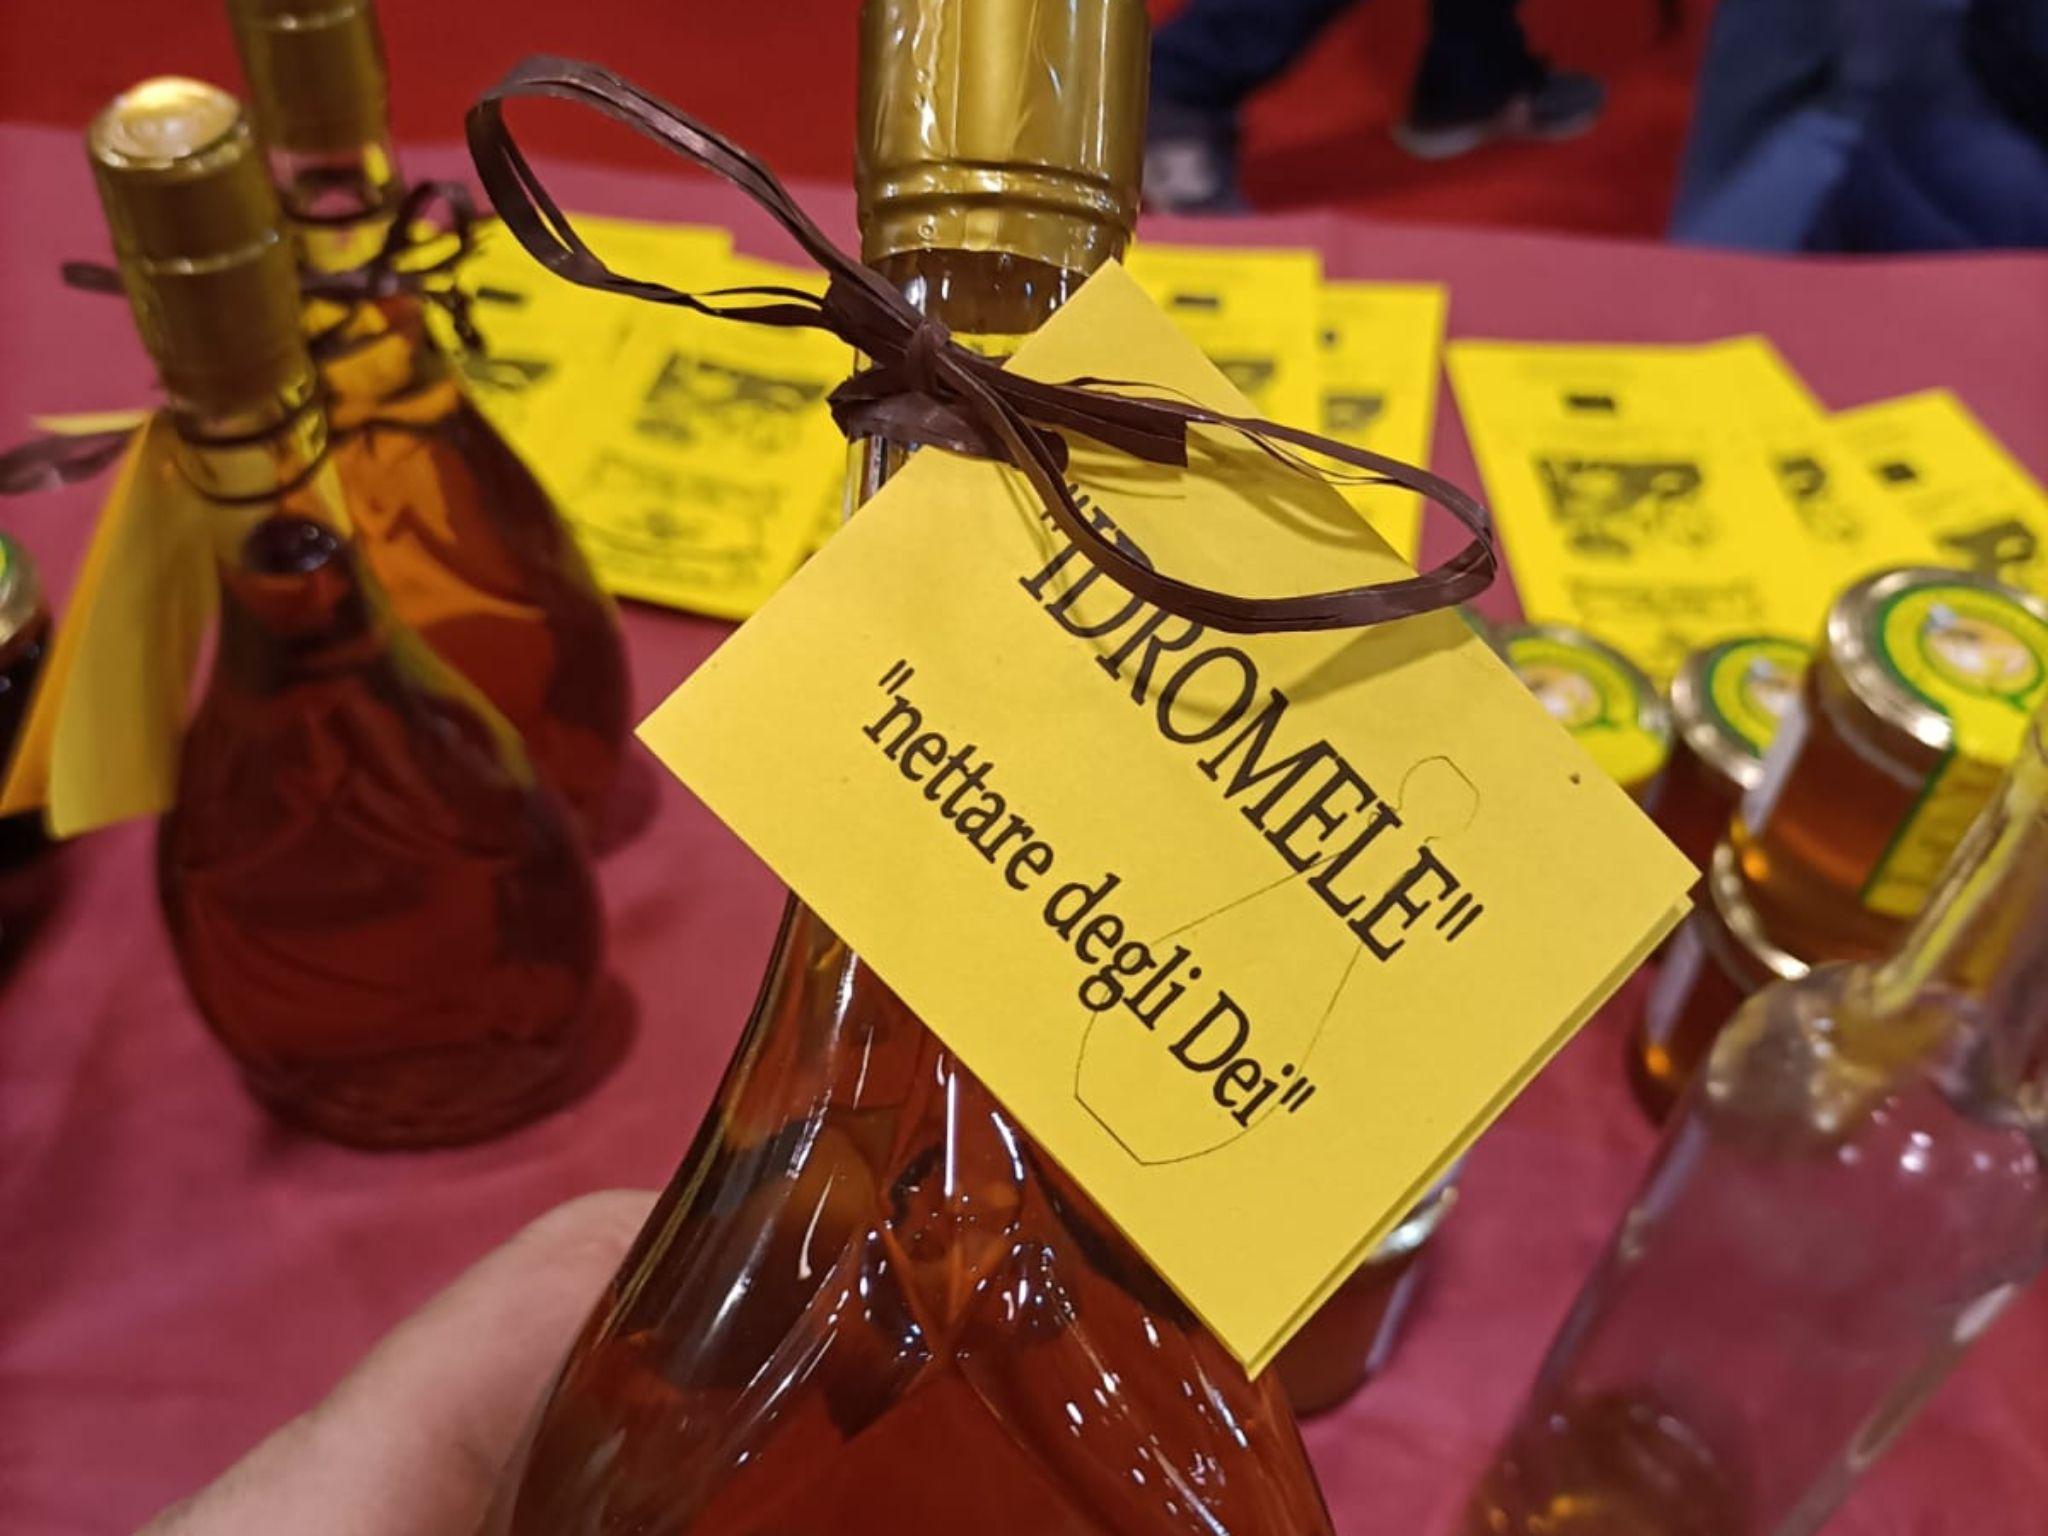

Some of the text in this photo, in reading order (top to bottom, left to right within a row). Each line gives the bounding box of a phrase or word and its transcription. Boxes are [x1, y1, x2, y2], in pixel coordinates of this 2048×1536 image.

[863, 659, 1316, 1128] "nettare degli Dei"
